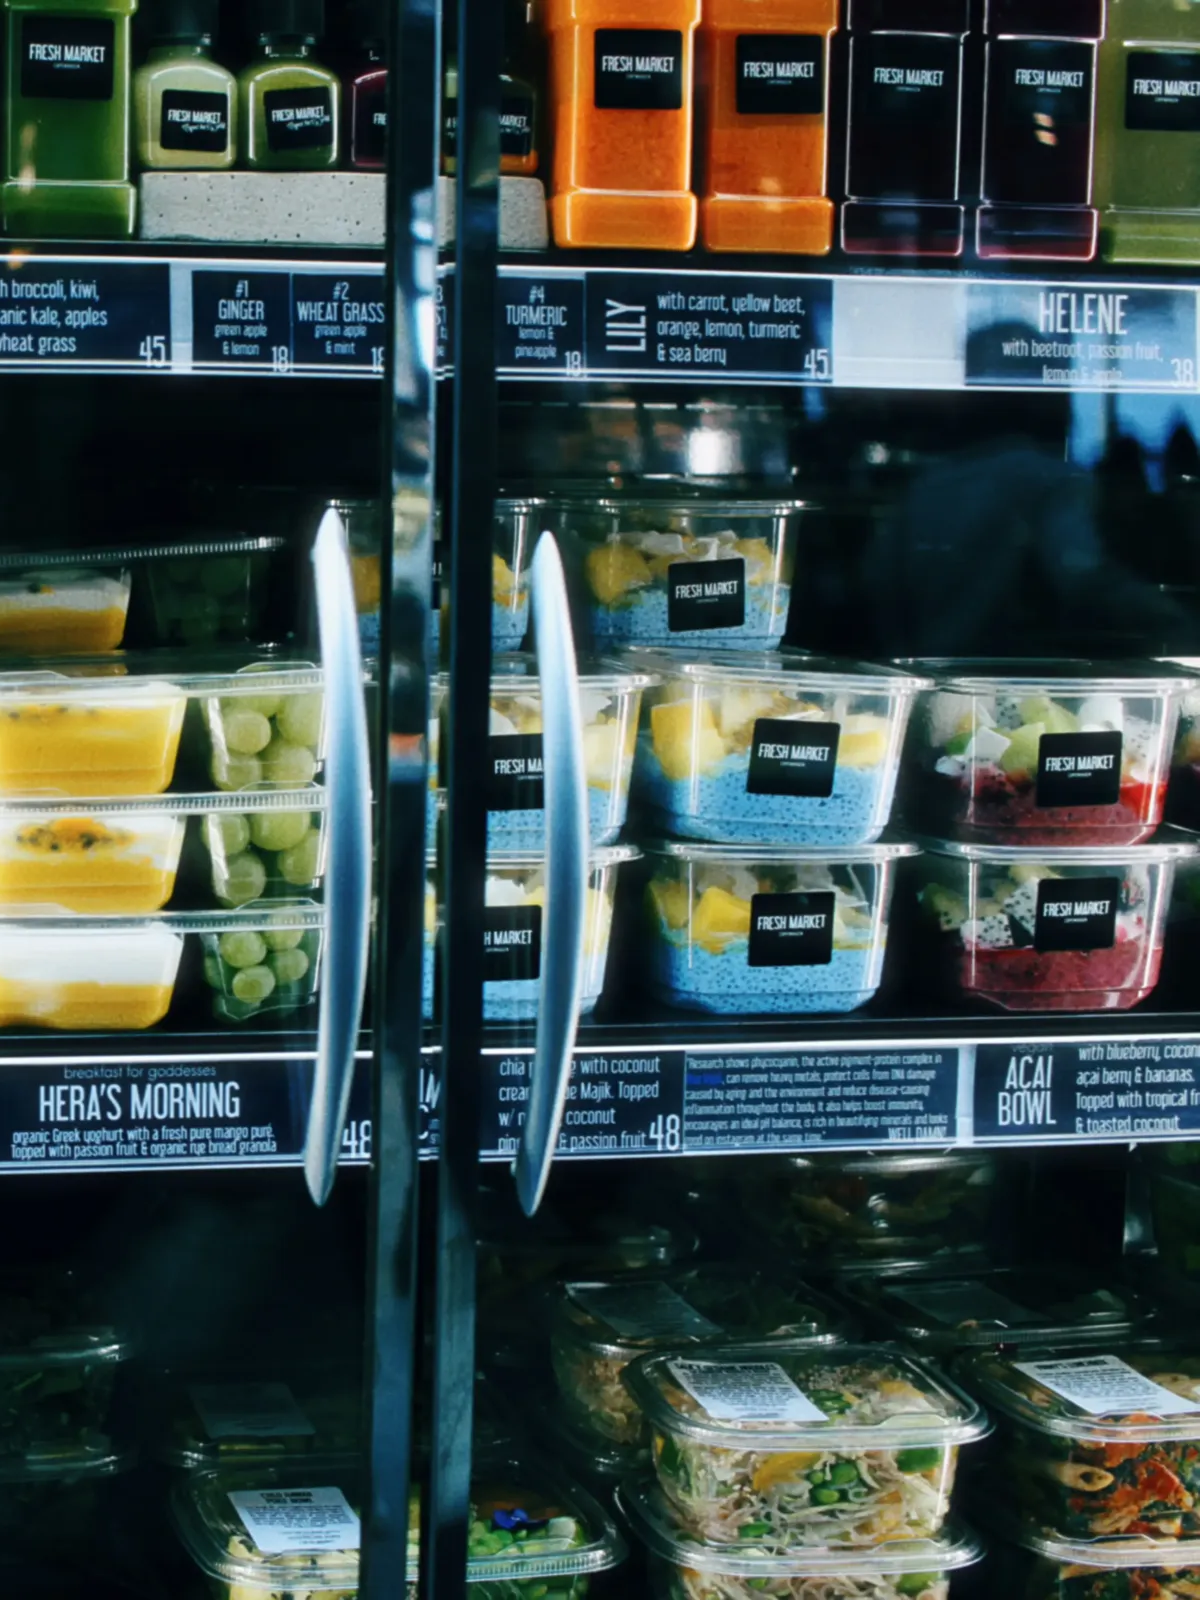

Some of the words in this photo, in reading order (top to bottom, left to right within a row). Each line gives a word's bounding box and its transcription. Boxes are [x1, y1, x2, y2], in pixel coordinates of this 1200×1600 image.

[602, 56, 632, 72] FRESH
[635, 57, 674, 72] MARKET
[1134, 79, 1162, 95] FRESH
[1164, 80, 1200, 96] MARKET
[272, 108, 294, 122] FRESH
[296, 105, 325, 121] MARKET
[12, 280, 67, 301] broccoli,
[70, 280, 100, 302] kiwi,
[235, 280, 249, 298] #1
[333, 282, 349, 300] #2
[529, 286, 545, 303] #4
[218, 299, 264, 320] GINGER
[298, 302, 340, 322] WHEAT
[343, 302, 385, 323] GRASS
[657, 291, 685, 312] with
[688, 294, 728, 314] carrot,
[732, 294, 770, 314] yellow
[774, 295, 806, 316] beet,
[1039, 292, 1128, 335] HELENE
[30, 306, 61, 328] kale,
[65, 307, 108, 328] apples
[505, 305, 567, 326] TURMERIC
[606, 299, 646, 351] LILY
[657, 320, 702, 339] orange,
[705, 318, 745, 339] lemon,
[749, 321, 801, 340] turmeric
[38, 336, 76, 355] grass
[140, 335, 166, 368] 45
[669, 346, 692, 362] sea
[694, 344, 726, 365] berry
[1002, 338, 1029, 356] with
[272, 346, 288, 372] 18
[565, 351, 581, 377] 18
[804, 348, 828, 380] 45
[1171, 359, 1193, 387] 38
[758, 743, 787, 759] FRESH
[791, 746, 830, 761] MARKET
[1045, 757, 1075, 772] FRESH
[1077, 755, 1114, 770] MARKET
[757, 916, 786, 931] FRESH
[789, 915, 825, 930] MARKET
[1078, 1045, 1104, 1061] with
[1107, 1044, 1161, 1062] blueberry,
[148, 1065, 216, 1081] goddesses
[500, 1057, 525, 1076] chia
[580, 1056, 608, 1074] with
[611, 1056, 660, 1074] coconut
[1103, 1068, 1131, 1087] berry
[1145, 1067, 1195, 1083] bananas.
[39, 1083, 121, 1122] HERA'S
[130, 1081, 240, 1121] MORNING
[581, 1081, 614, 1102] Majik.
[618, 1081, 659, 1101] Topped
[1075, 1092, 1114, 1112] Topped
[1117, 1090, 1142, 1108] with
[1145, 1089, 1188, 1110] tropical
[498, 1108, 515, 1126] w/
[566, 1108, 616, 1125] coconut
[998, 1091, 1057, 1126] BOWL
[649, 1114, 680, 1152] 48
[1087, 1116, 1131, 1134] toasted
[1134, 1115, 1180, 1133] coconut
[12, 1129, 50, 1144] organic
[52, 1128, 81, 1142] Greek
[83, 1128, 123, 1145] yoghurt
[127, 1126, 149, 1141] with
[162, 1126, 187, 1140] fresh
[190, 1128, 211, 1143] pure
[214, 1127, 248, 1142] mango
[343, 1120, 372, 1158] 48
[570, 1133, 617, 1152] passion
[621, 1130, 647, 1148] fruit
[11, 1144, 45, 1161] Topped
[49, 1142, 71, 1157] with
[74, 1143, 113, 1160] passion
[116, 1141, 137, 1156] fruit
[150, 1141, 187, 1157] organic
[209, 1139, 236, 1154] bread
[239, 1139, 277, 1156] granola
